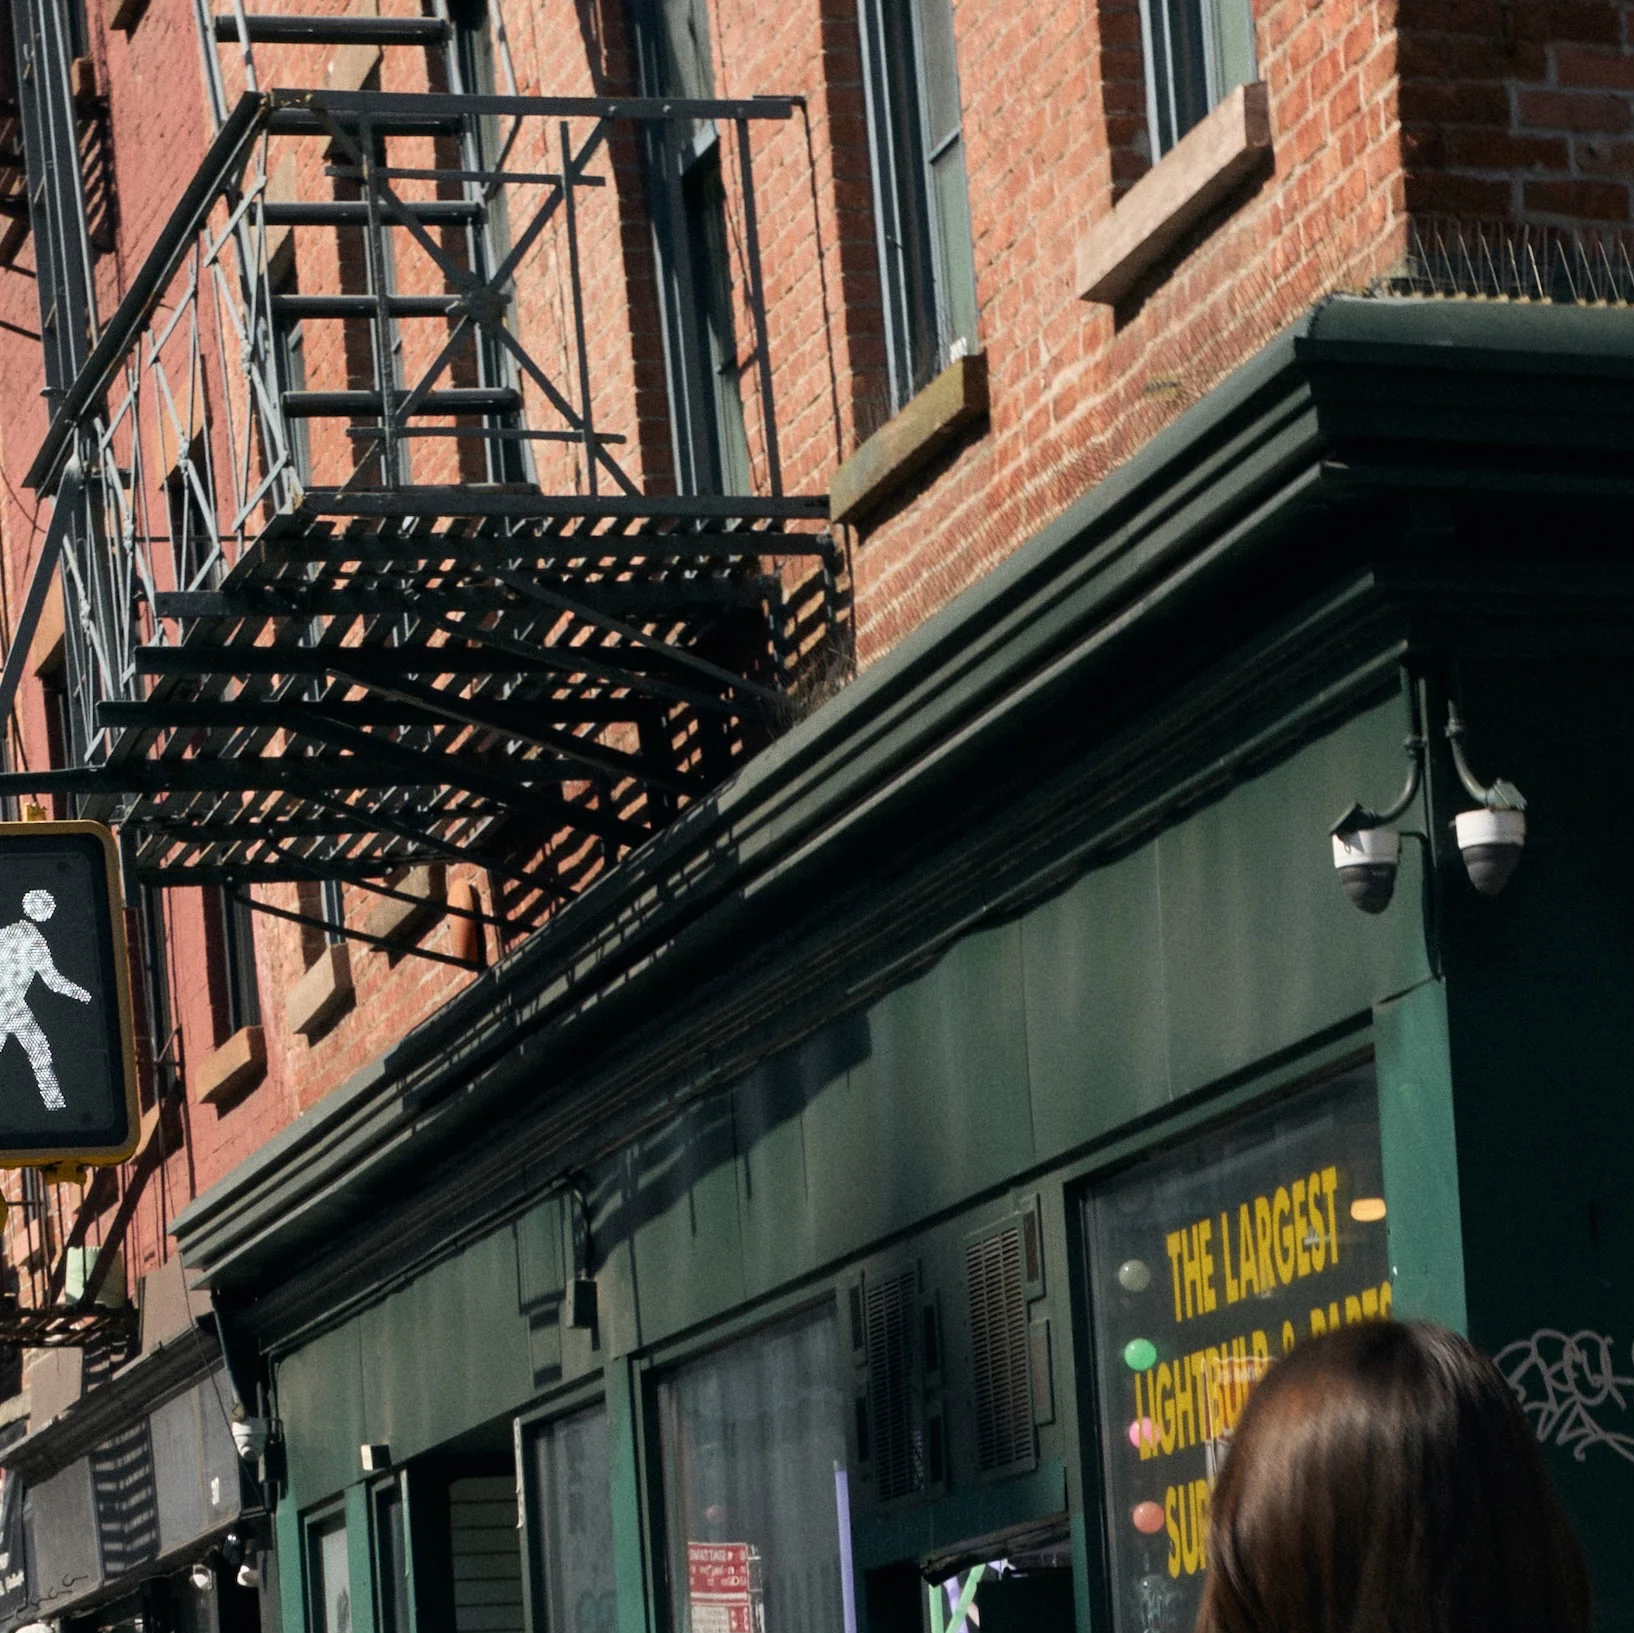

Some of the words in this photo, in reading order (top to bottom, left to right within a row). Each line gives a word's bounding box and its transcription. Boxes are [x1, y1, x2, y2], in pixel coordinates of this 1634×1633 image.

[1167, 1219, 1217, 1322] THE
[1221, 1166, 1339, 1304] LARGEST
[1165, 1479, 1214, 1579] SUP
